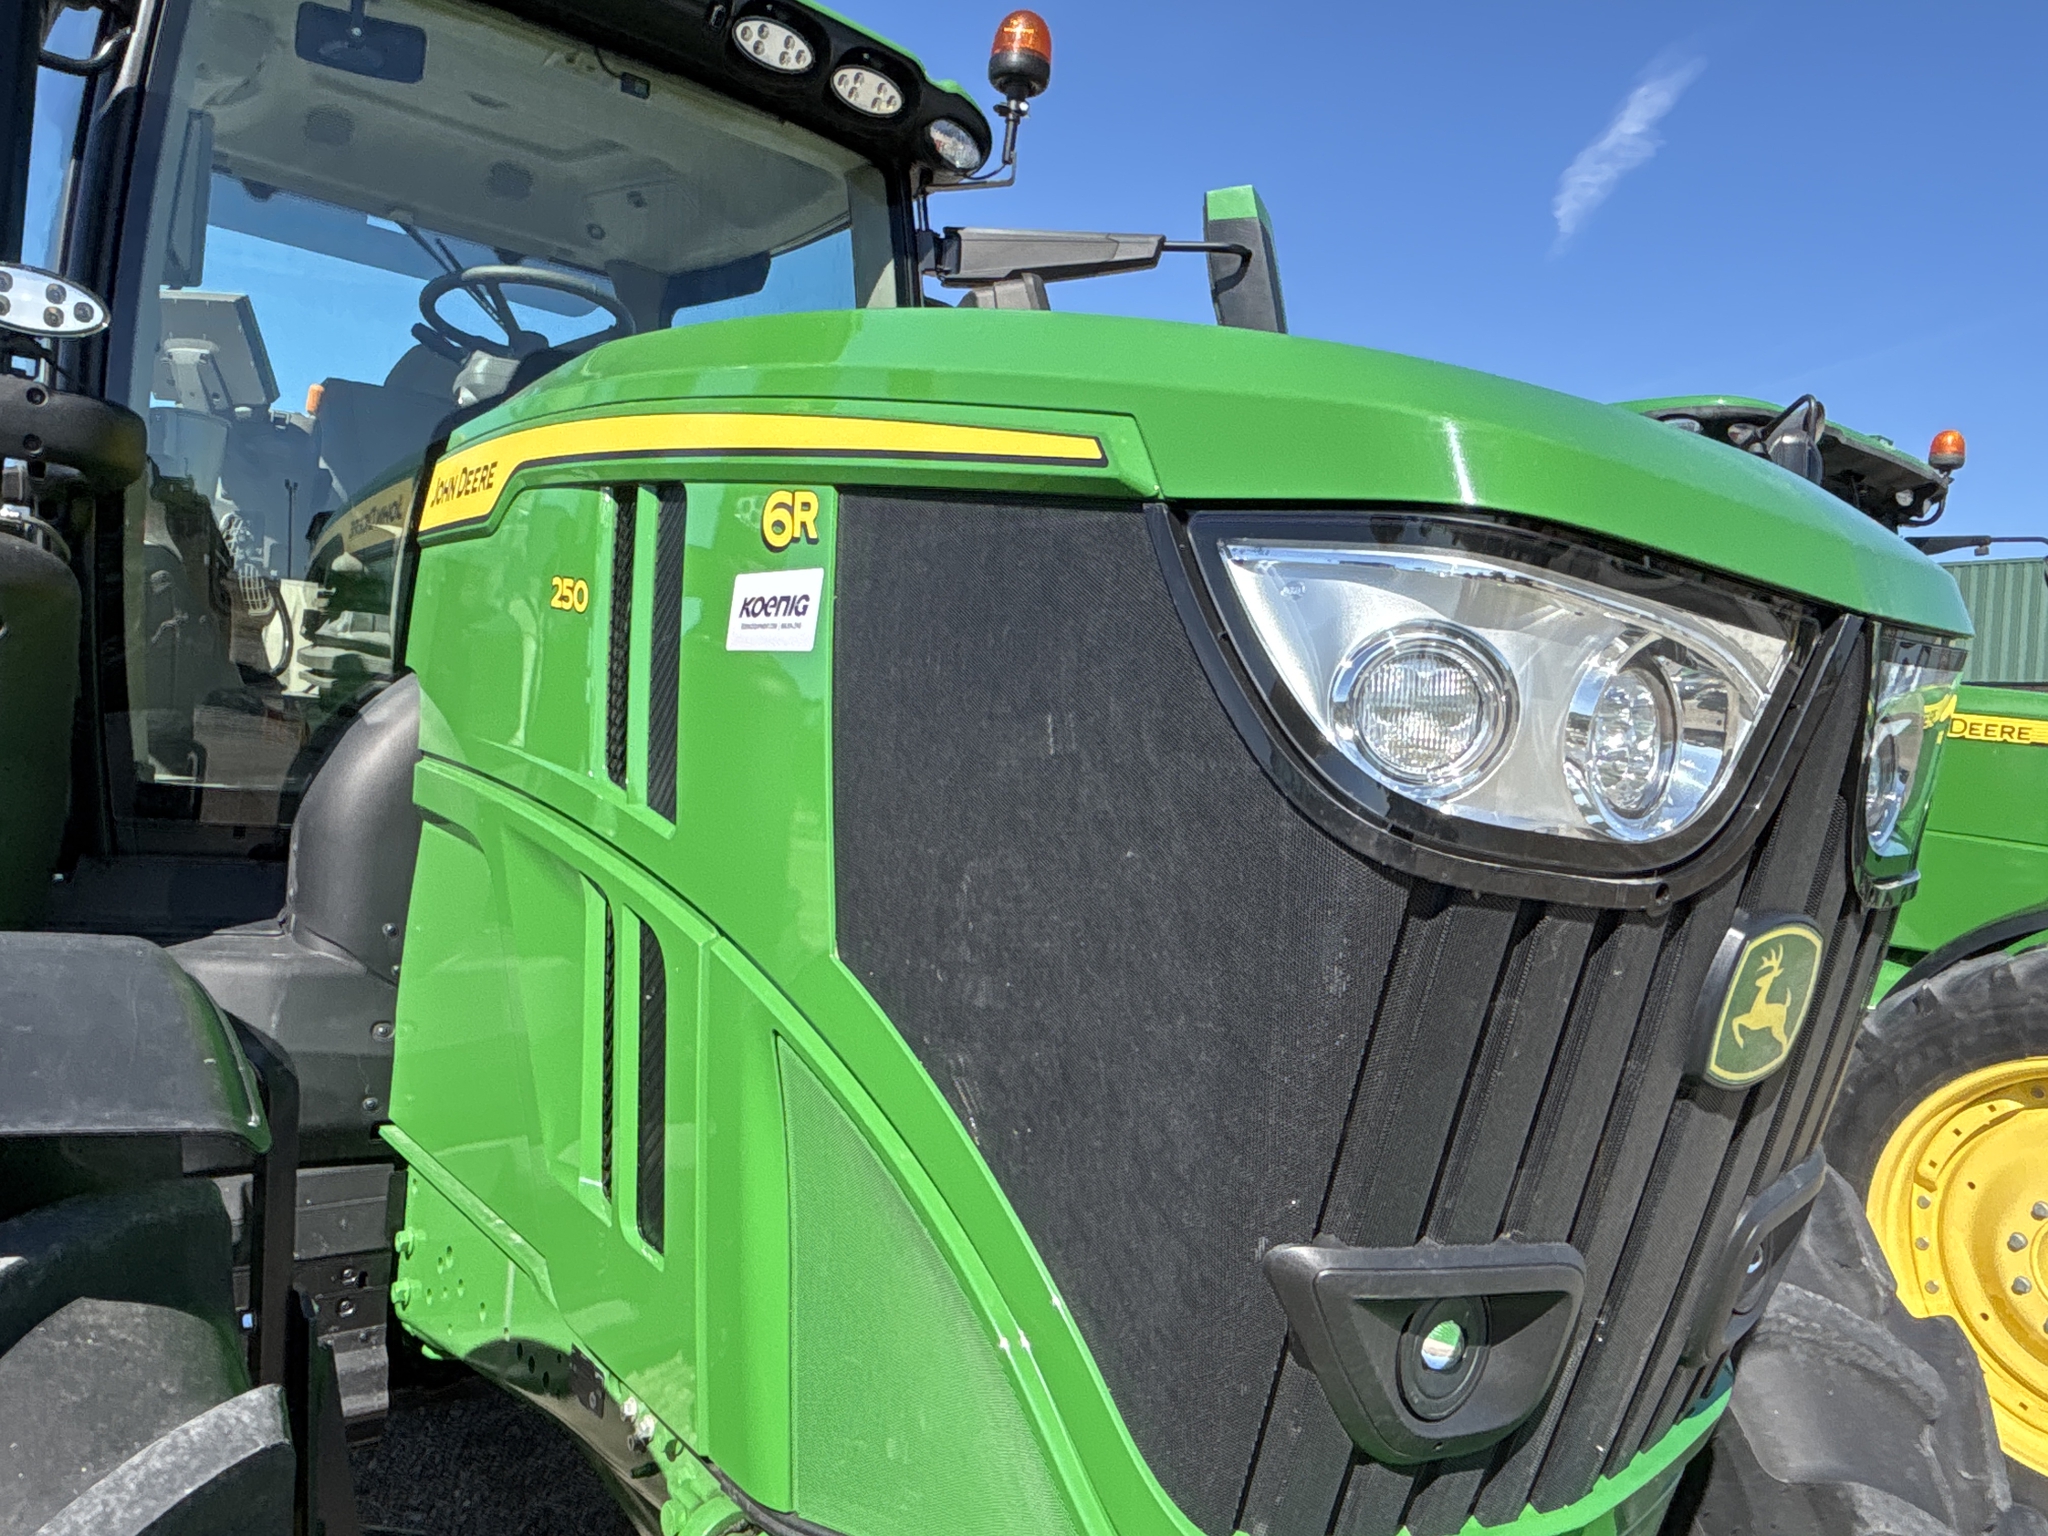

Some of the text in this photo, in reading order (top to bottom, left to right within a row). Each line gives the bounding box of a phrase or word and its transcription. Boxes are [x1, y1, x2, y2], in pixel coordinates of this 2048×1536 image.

[430, 461, 498, 508] JOHN DEERE
[761, 490, 819, 552] 6R
[550, 576, 589, 613] 250
[1950, 718, 2033, 741] DEERE
